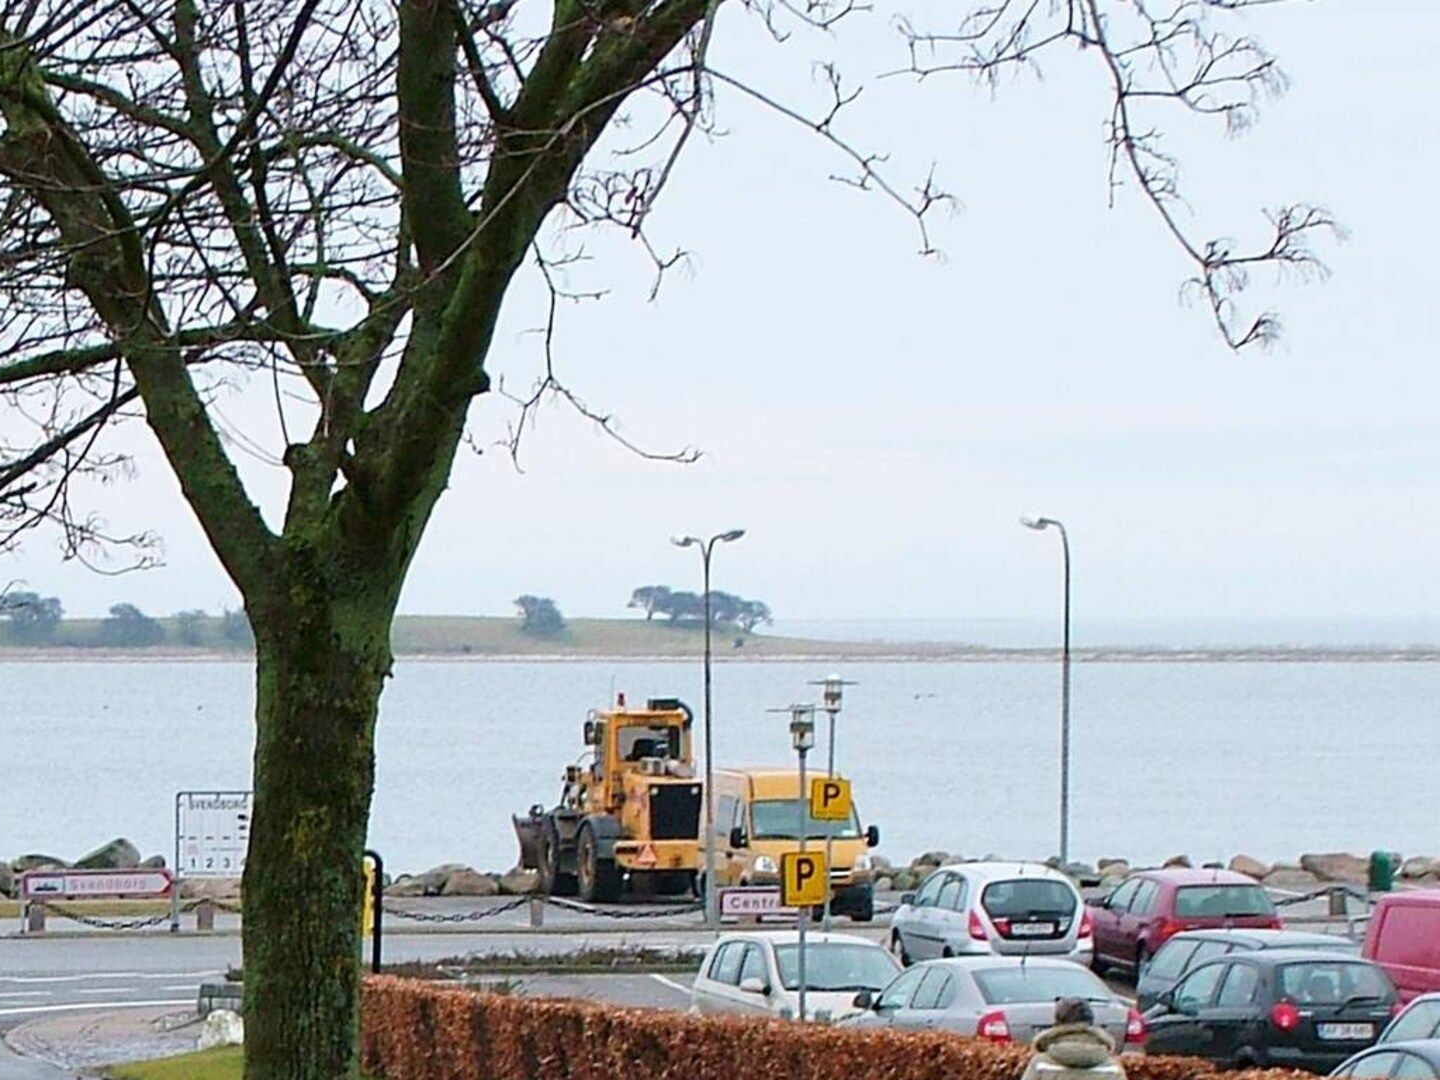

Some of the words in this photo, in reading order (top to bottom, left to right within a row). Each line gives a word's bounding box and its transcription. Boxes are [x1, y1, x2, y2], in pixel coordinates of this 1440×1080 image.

[823, 783, 840, 808] P
[206, 857, 213, 869] 2
[224, 857, 231, 869] 3
[796, 857, 814, 892] P
[69, 878, 148, 891] Svendborg
